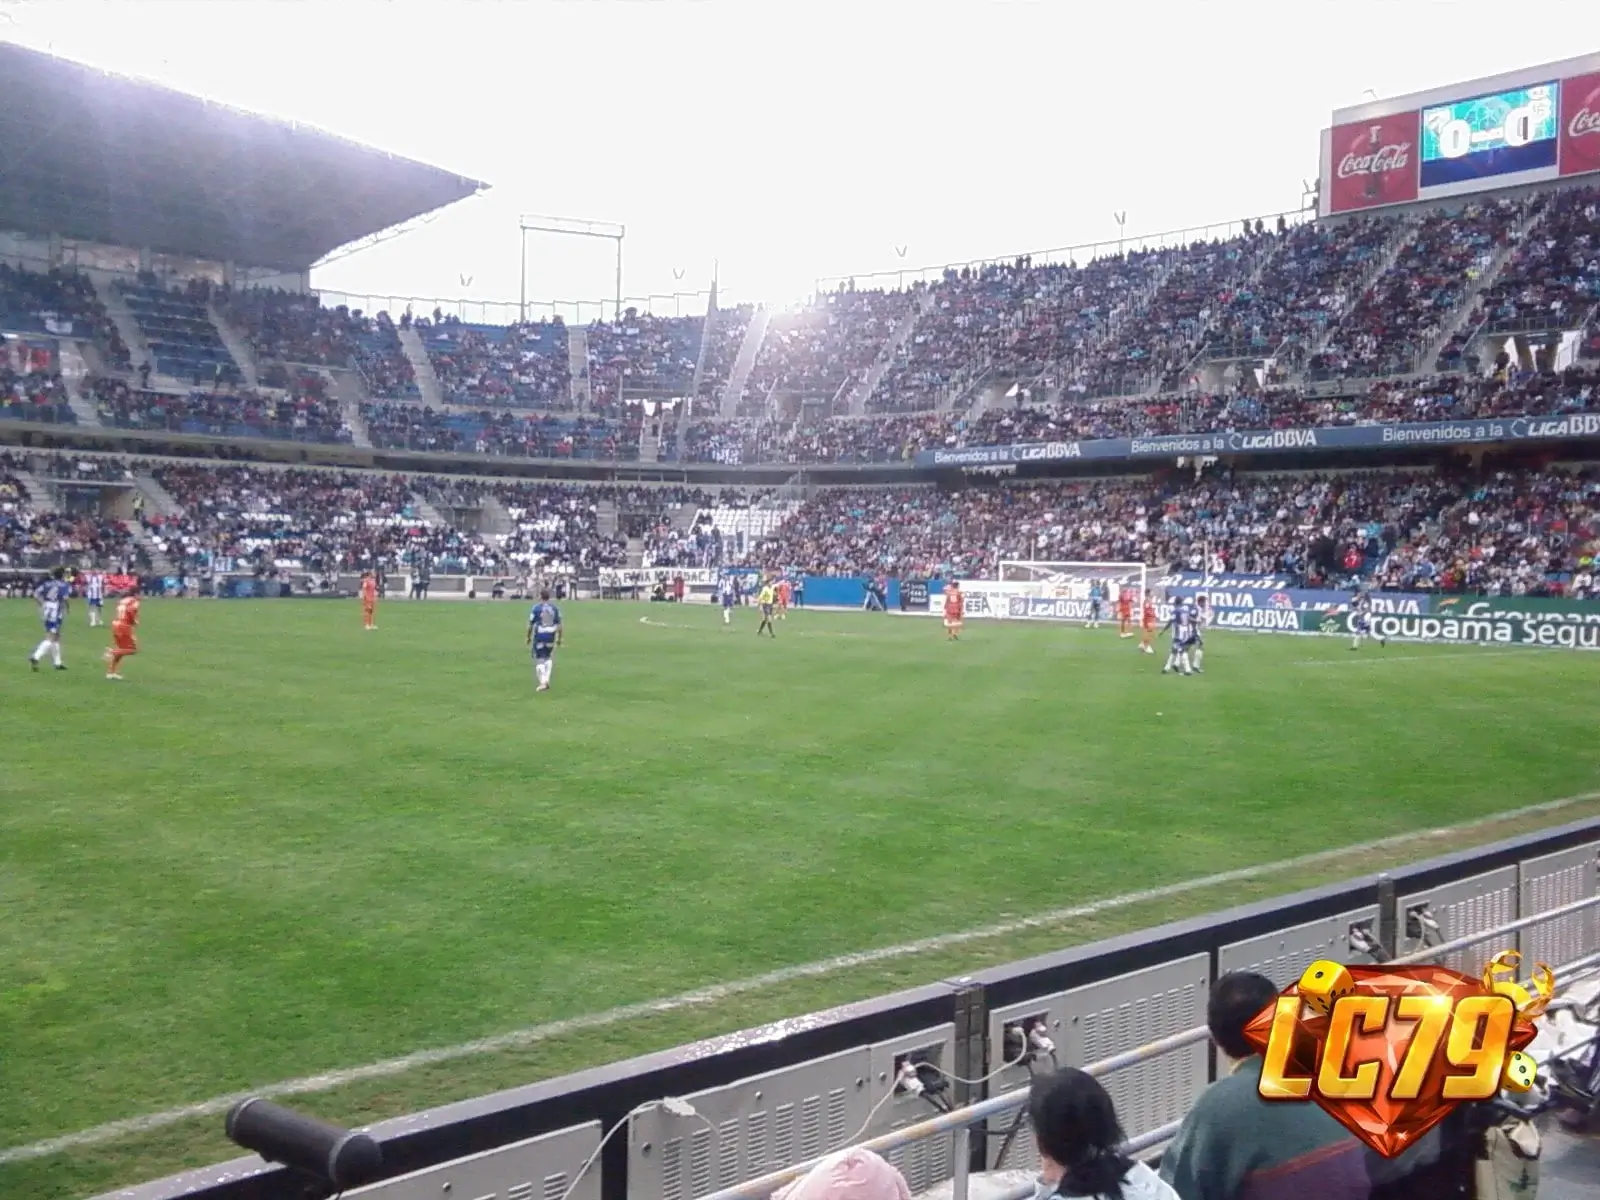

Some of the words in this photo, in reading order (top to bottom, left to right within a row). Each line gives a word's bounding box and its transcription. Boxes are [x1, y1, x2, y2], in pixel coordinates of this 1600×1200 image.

[1383, 426, 1470, 441] Bienvenidos
[1475, 428, 1485, 436] a
[1490, 424, 1503, 437] la
[1131, 439, 1199, 453] Bienvenidos
[1202, 440, 1211, 449] a
[1213, 437, 1224, 449] la
[934, 450, 988, 463] Bienvenidos
[1000, 449, 1009, 460] la
